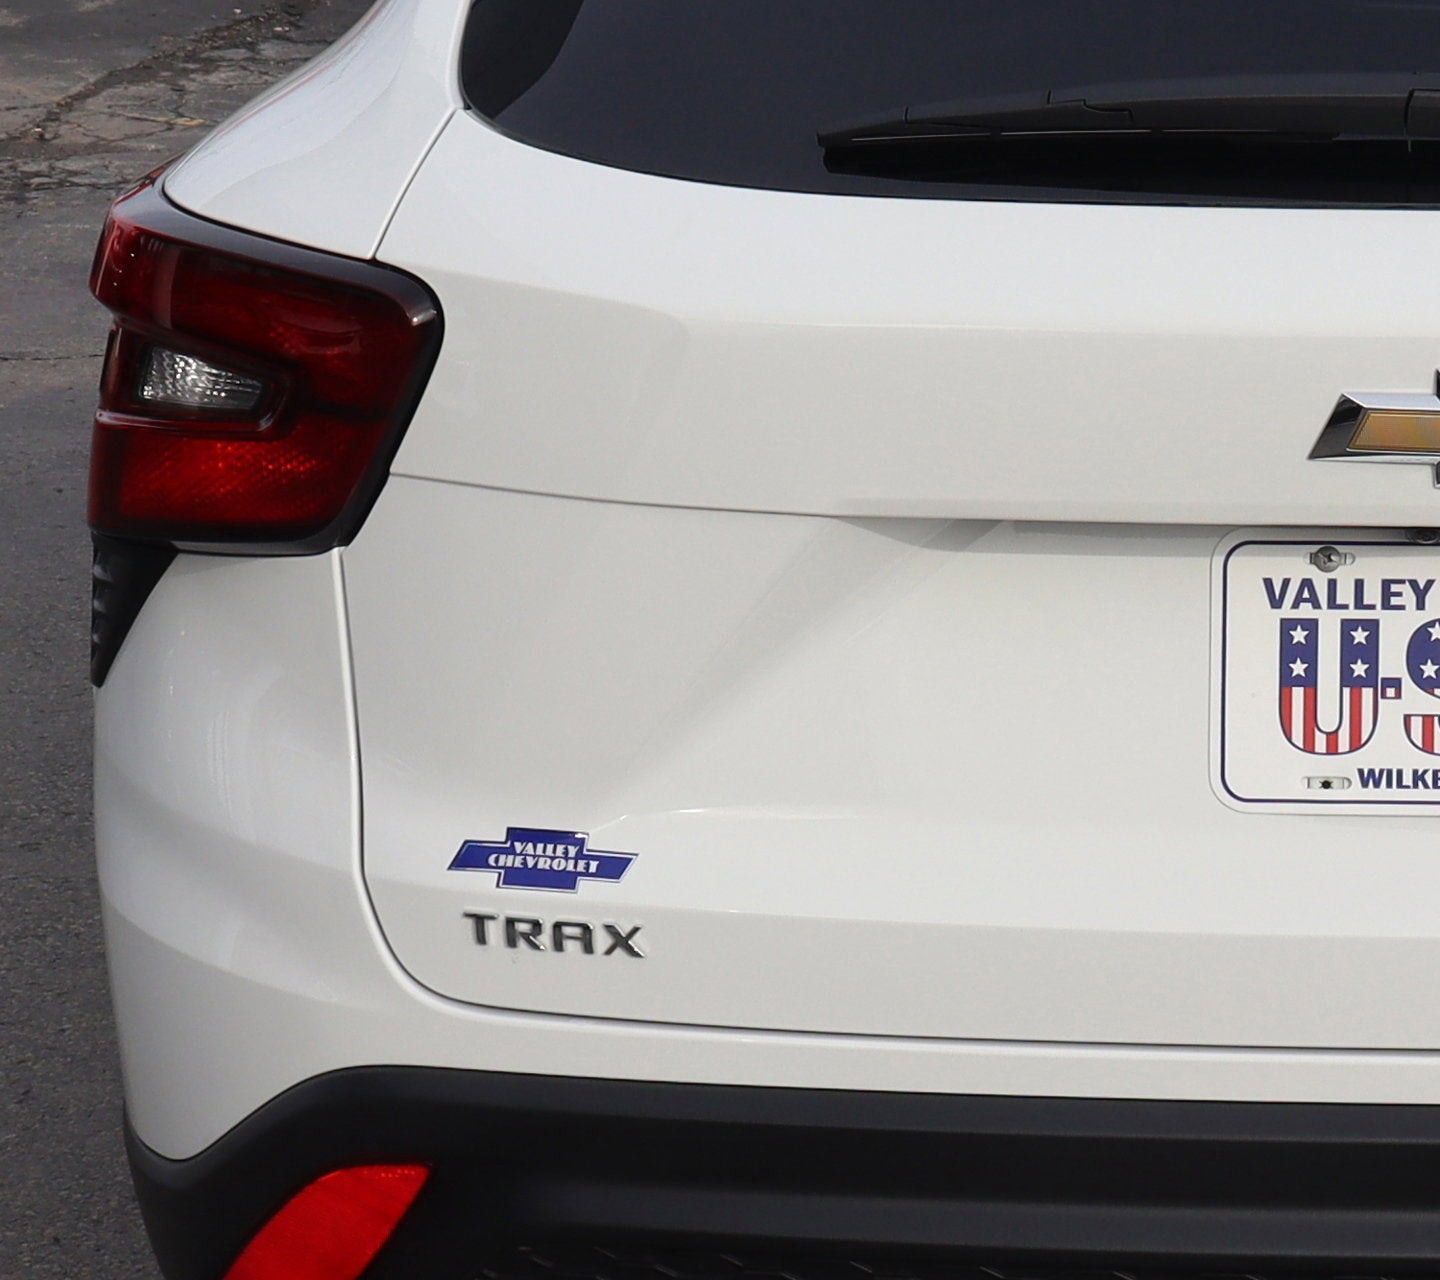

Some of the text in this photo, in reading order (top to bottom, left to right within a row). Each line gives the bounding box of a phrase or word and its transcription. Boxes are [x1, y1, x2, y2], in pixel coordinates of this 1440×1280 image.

[1262, 577, 1436, 611] VALLEY
[513, 841, 580, 858] VALLEY
[487, 853, 600, 874] CHEVROLET
[462, 911, 646, 959] TRAX
